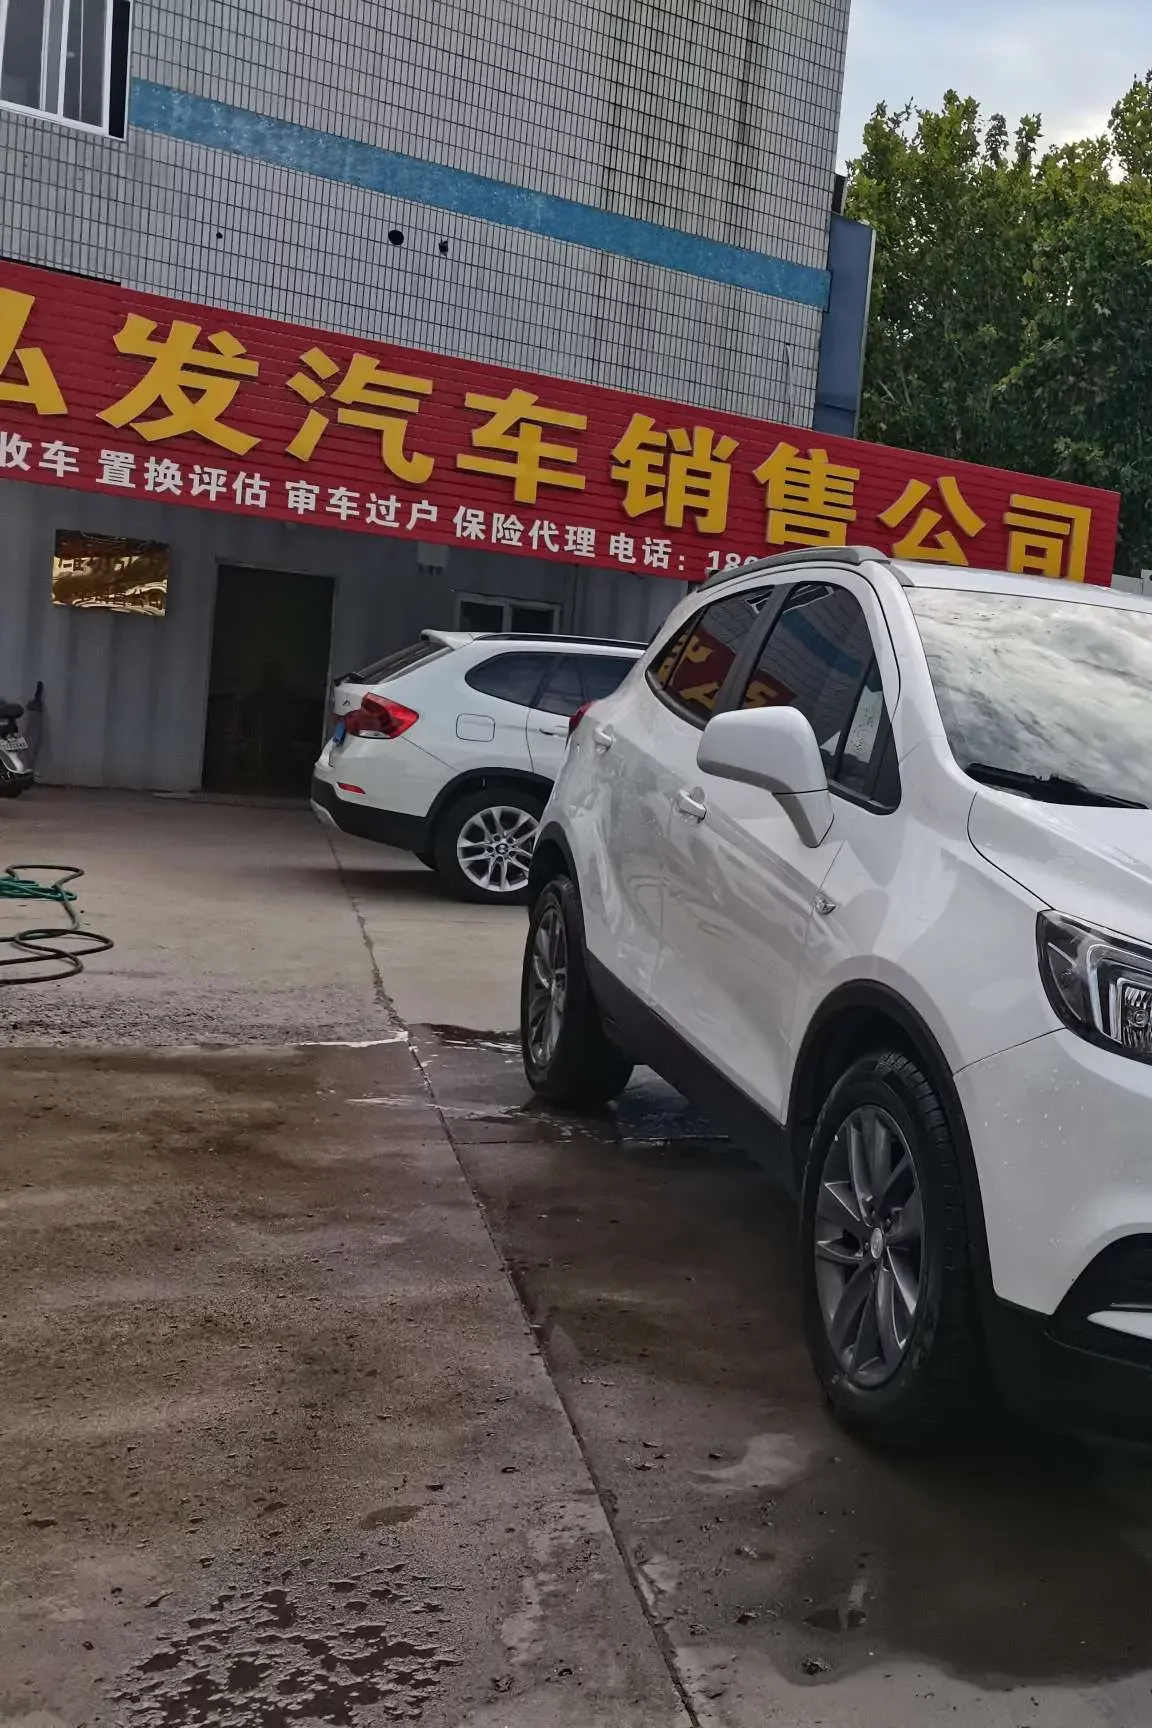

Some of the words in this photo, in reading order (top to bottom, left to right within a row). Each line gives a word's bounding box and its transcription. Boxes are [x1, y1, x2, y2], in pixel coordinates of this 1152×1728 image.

[96, 448, 271, 509] 置换评估
[285, 479, 438, 531] 审车过户
[453, 505, 597, 559] 保险代理
